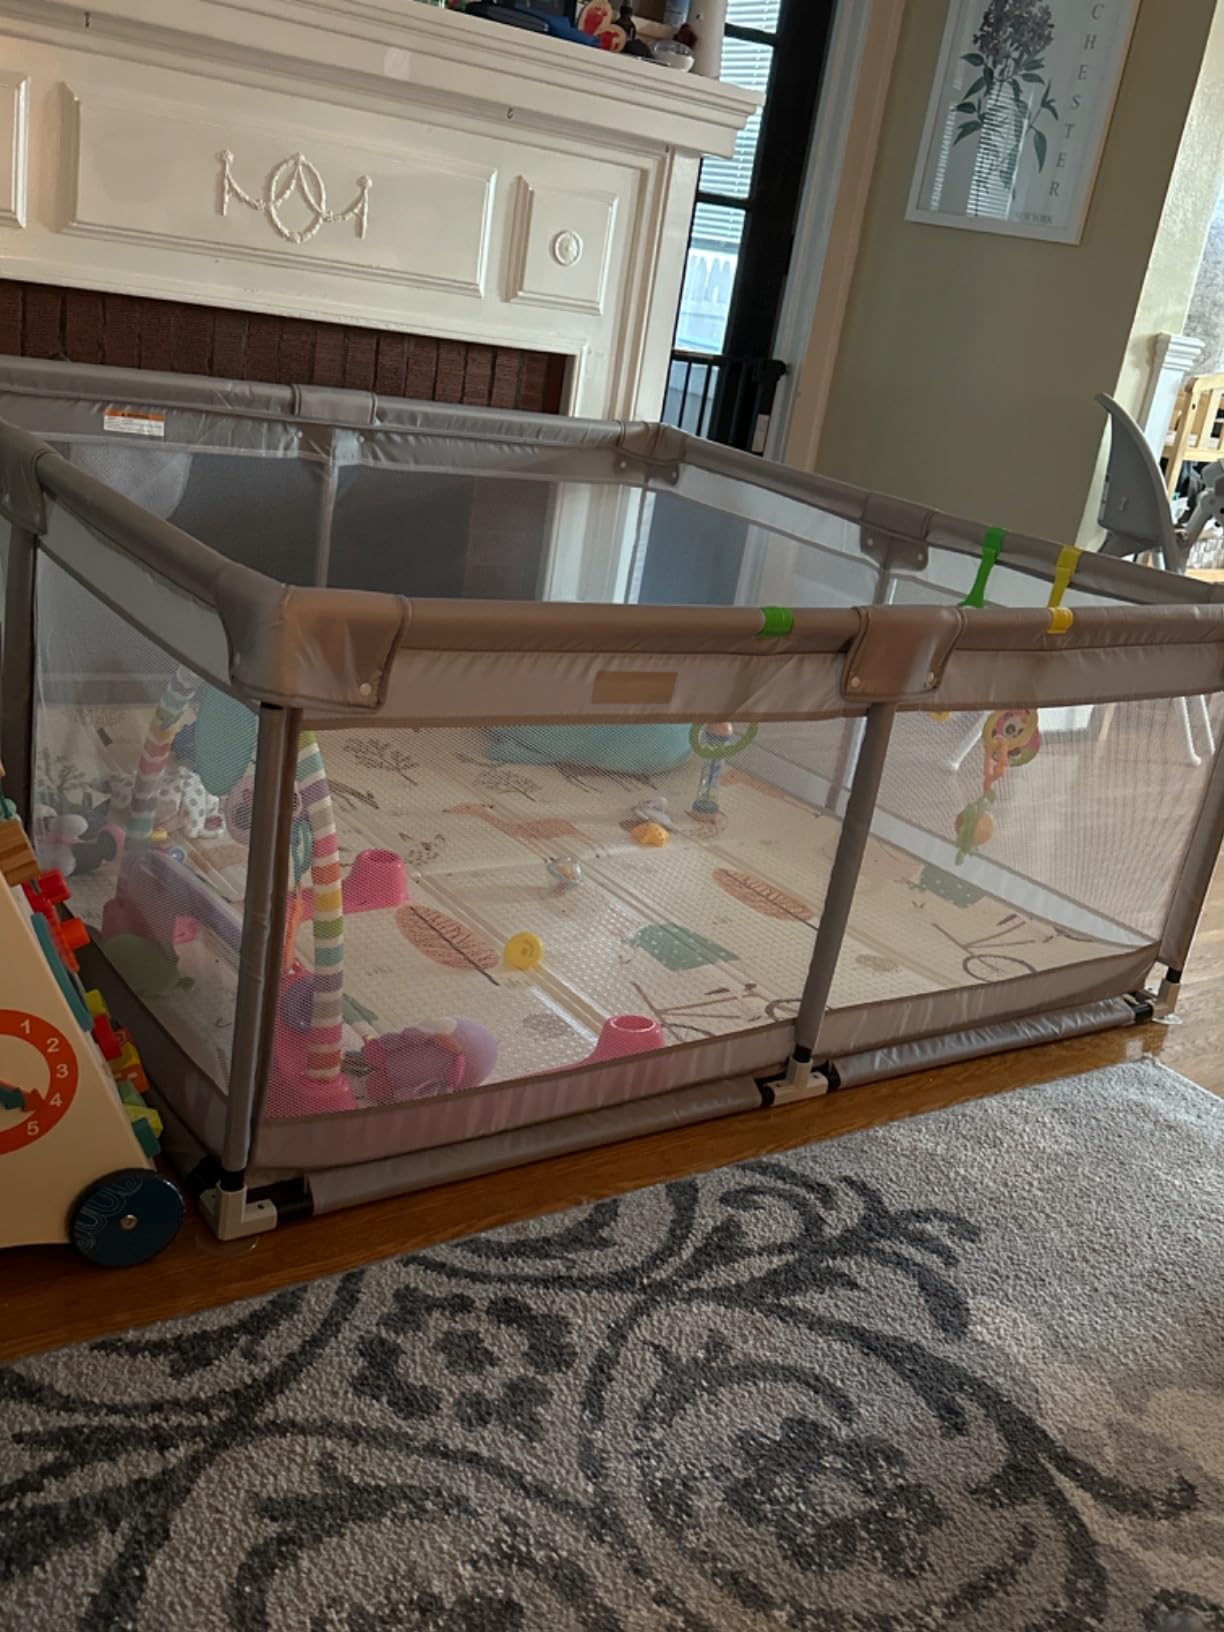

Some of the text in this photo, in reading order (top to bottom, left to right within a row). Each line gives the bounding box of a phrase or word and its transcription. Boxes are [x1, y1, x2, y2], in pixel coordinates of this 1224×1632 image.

[1048, 3, 1105, 198] CHESTER
[21, 1019, 31, 1034] 1
[47, 1038, 60, 1052] 2
[56, 1064, 69, 1078] 3
[50, 1093, 62, 1107] 4
[27, 1121, 39, 1135] 5
